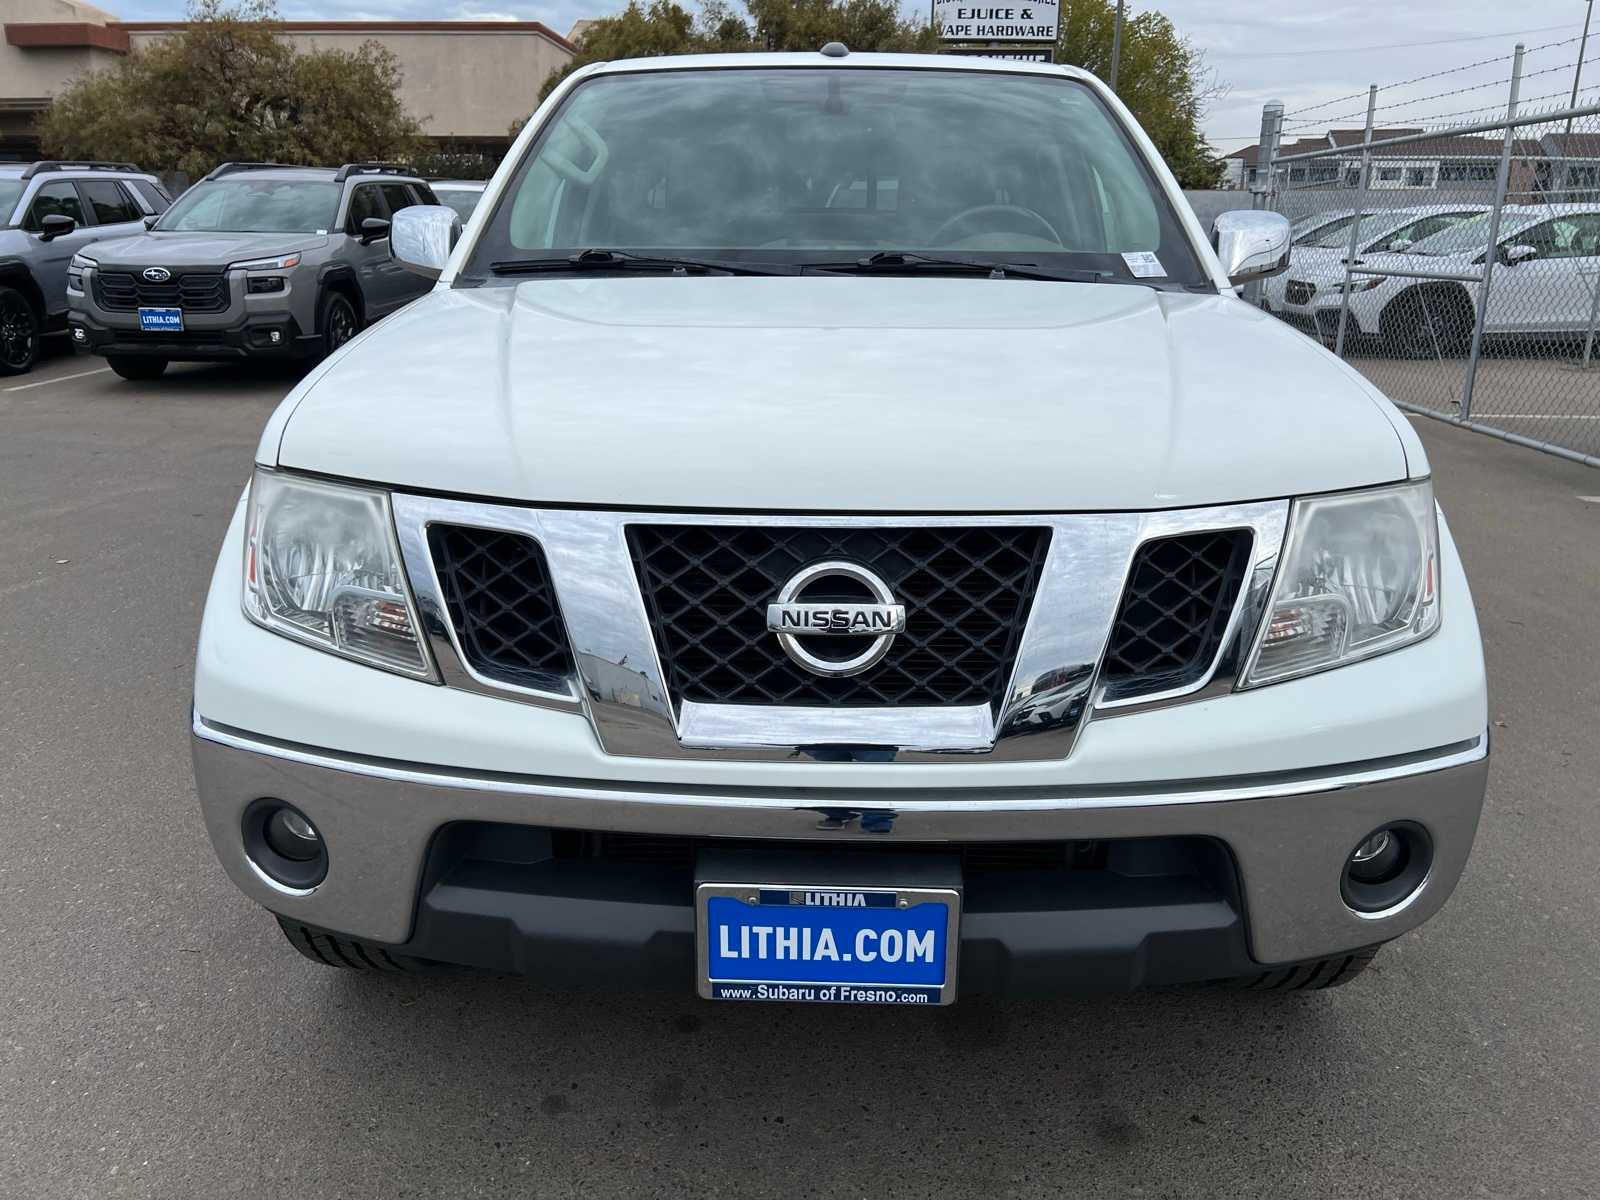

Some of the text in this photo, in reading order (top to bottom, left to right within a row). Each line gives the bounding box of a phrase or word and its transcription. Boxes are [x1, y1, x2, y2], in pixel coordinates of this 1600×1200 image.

[957, 8, 1034, 20] EJUICE &
[976, 25, 1054, 37] HARDWARE
[142, 315, 180, 324] LITHIA.COM
[781, 610, 892, 628] NISSAN
[805, 892, 866, 908] LITHIA
[719, 924, 936, 963] LITHIA.COM
[720, 984, 929, 1003] www.Subaru of Fresno.com
